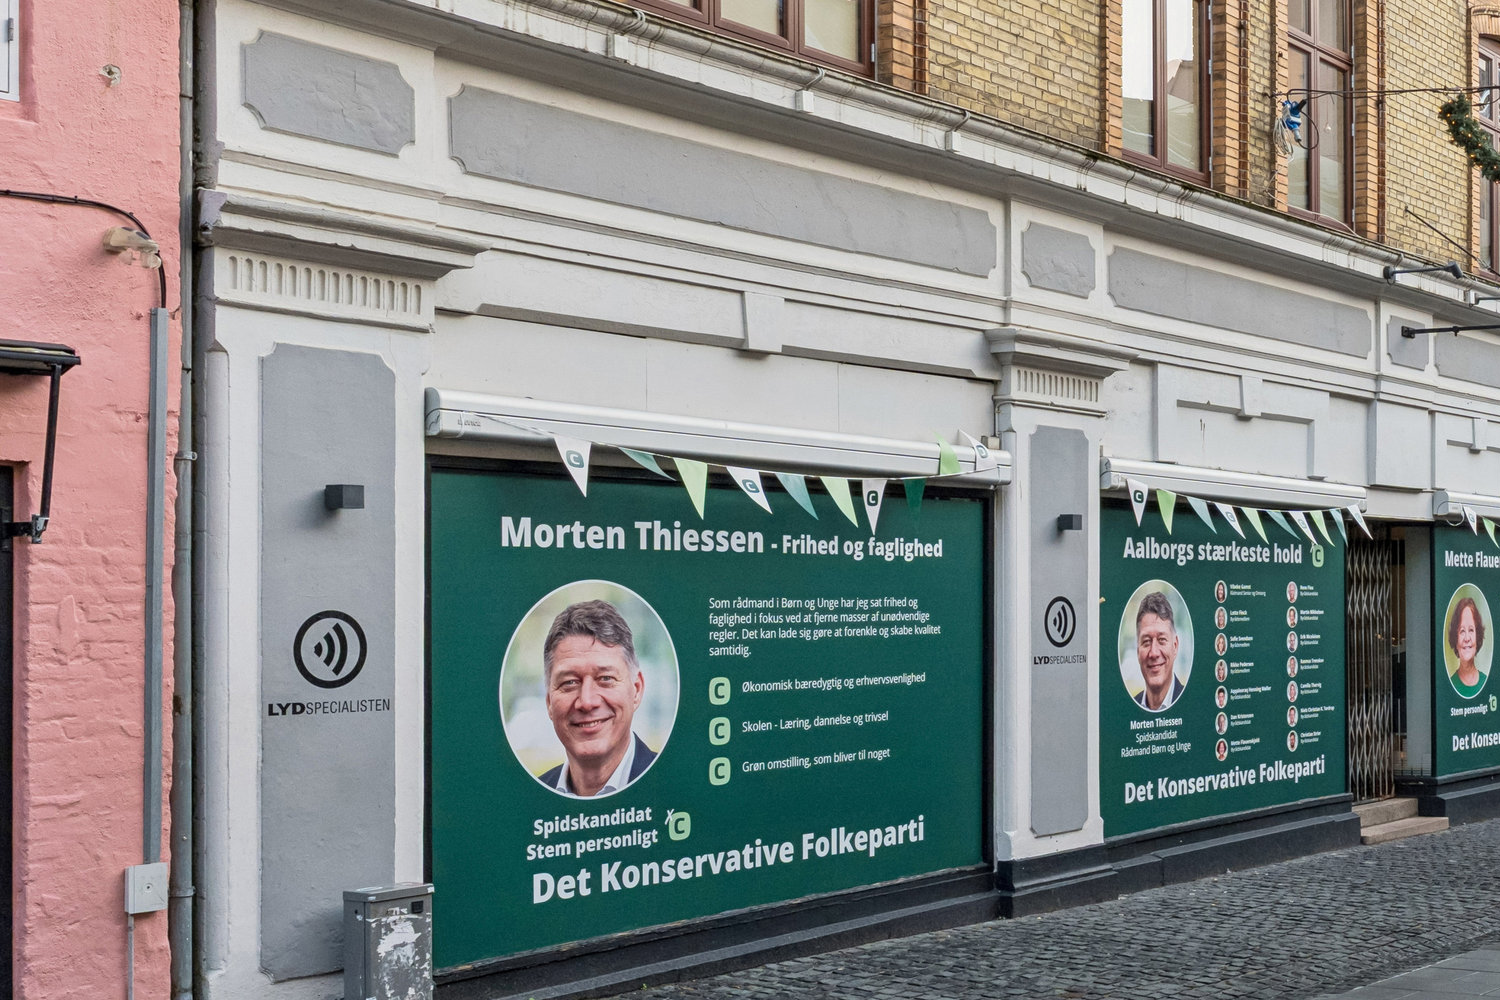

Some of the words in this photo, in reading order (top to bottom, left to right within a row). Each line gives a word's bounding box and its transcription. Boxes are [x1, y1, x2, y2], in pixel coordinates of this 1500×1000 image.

[501, 516, 625, 550] Morten
[634, 520, 764, 552] Thiessen
[782, 534, 839, 555] Frihed
[843, 540, 864, 562] og
[868, 536, 943, 562] faglighed
[1123, 536, 1194, 566] Aalborgs
[1198, 540, 1270, 563] stærkeste
[1274, 543, 1302, 564] hold
[1445, 550, 1472, 567] Mette
[709, 598, 730, 609] Som
[732, 596, 774, 608] rådmand
[781, 598, 802, 608] Børn
[805, 600, 815, 610] og
[817, 597, 839, 610] Unge
[841, 597, 854, 608] har
[856, 598, 868, 610] jeg
[870, 598, 882, 608] sat
[883, 597, 906, 608] frihed
[908, 599, 918, 610] og
[709, 612, 752, 627] faglighed
[759, 612, 784, 624] fokus
[785, 612, 801, 623] ved
[803, 614, 812, 623] at
[813, 612, 838, 625] fjerne
[840, 614, 868, 622] masser
[871, 611, 880, 622] af
[881, 611, 930, 624] unødvendige
[709, 628, 739, 642] regler.
[742, 628, 758, 640] Det
[760, 628, 776, 639] kan
[778, 627, 797, 638] lade
[799, 627, 811, 640] sig
[813, 629, 832, 640] gøre
[834, 628, 842, 637] at
[844, 625, 877, 637] forenkle
[879, 627, 889, 638] og
[891, 625, 913, 636] skabe
[914, 625, 941, 635] kvalitet
[709, 644, 752, 658] samtidig.
[1034, 655, 1086, 664] LYDSPECIALISTEN
[742, 678, 793, 693] Økonomisk
[795, 676, 842, 691] bæredygtig
[844, 678, 854, 689] og
[856, 672, 926, 686] erhvervsvenlighed
[268, 699, 390, 716] LYDSPECIALISTEN
[1450, 708, 1463, 716] Stem
[1464, 704, 1488, 717] personligt
[742, 721, 772, 733] Skolen
[780, 717, 811, 731] Læring,
[814, 714, 851, 727] dannelse
[853, 715, 863, 725] og
[865, 711, 889, 722] trivsel
[1130, 718, 1154, 730] Morten
[1155, 716, 1182, 727] Thiessen
[1136, 730, 1177, 744] Spidskandidat
[1452, 734, 1469, 752] Det
[1121, 746, 1150, 758] Rådmand
[1152, 745, 1166, 754] Børn
[1167, 745, 1174, 754] og
[1176, 741, 1191, 752] Unge
[742, 761, 765, 772] Grøn
[768, 756, 812, 770] omstilling,
[814, 755, 832, 766] som
[834, 751, 856, 764] bliver
[858, 749, 866, 760] til
[868, 748, 890, 761] noget
[1125, 780, 1153, 804] Det
[1158, 766, 1256, 799] Konservative
[1260, 754, 1325, 784] Folkeparti
[533, 806, 652, 839] Spidskandidat
[526, 838, 571, 861] Stem
[575, 828, 658, 859] personligt
[532, 868, 592, 904] Det
[601, 839, 795, 893] Konservative
[802, 815, 925, 860] Folkeparti
